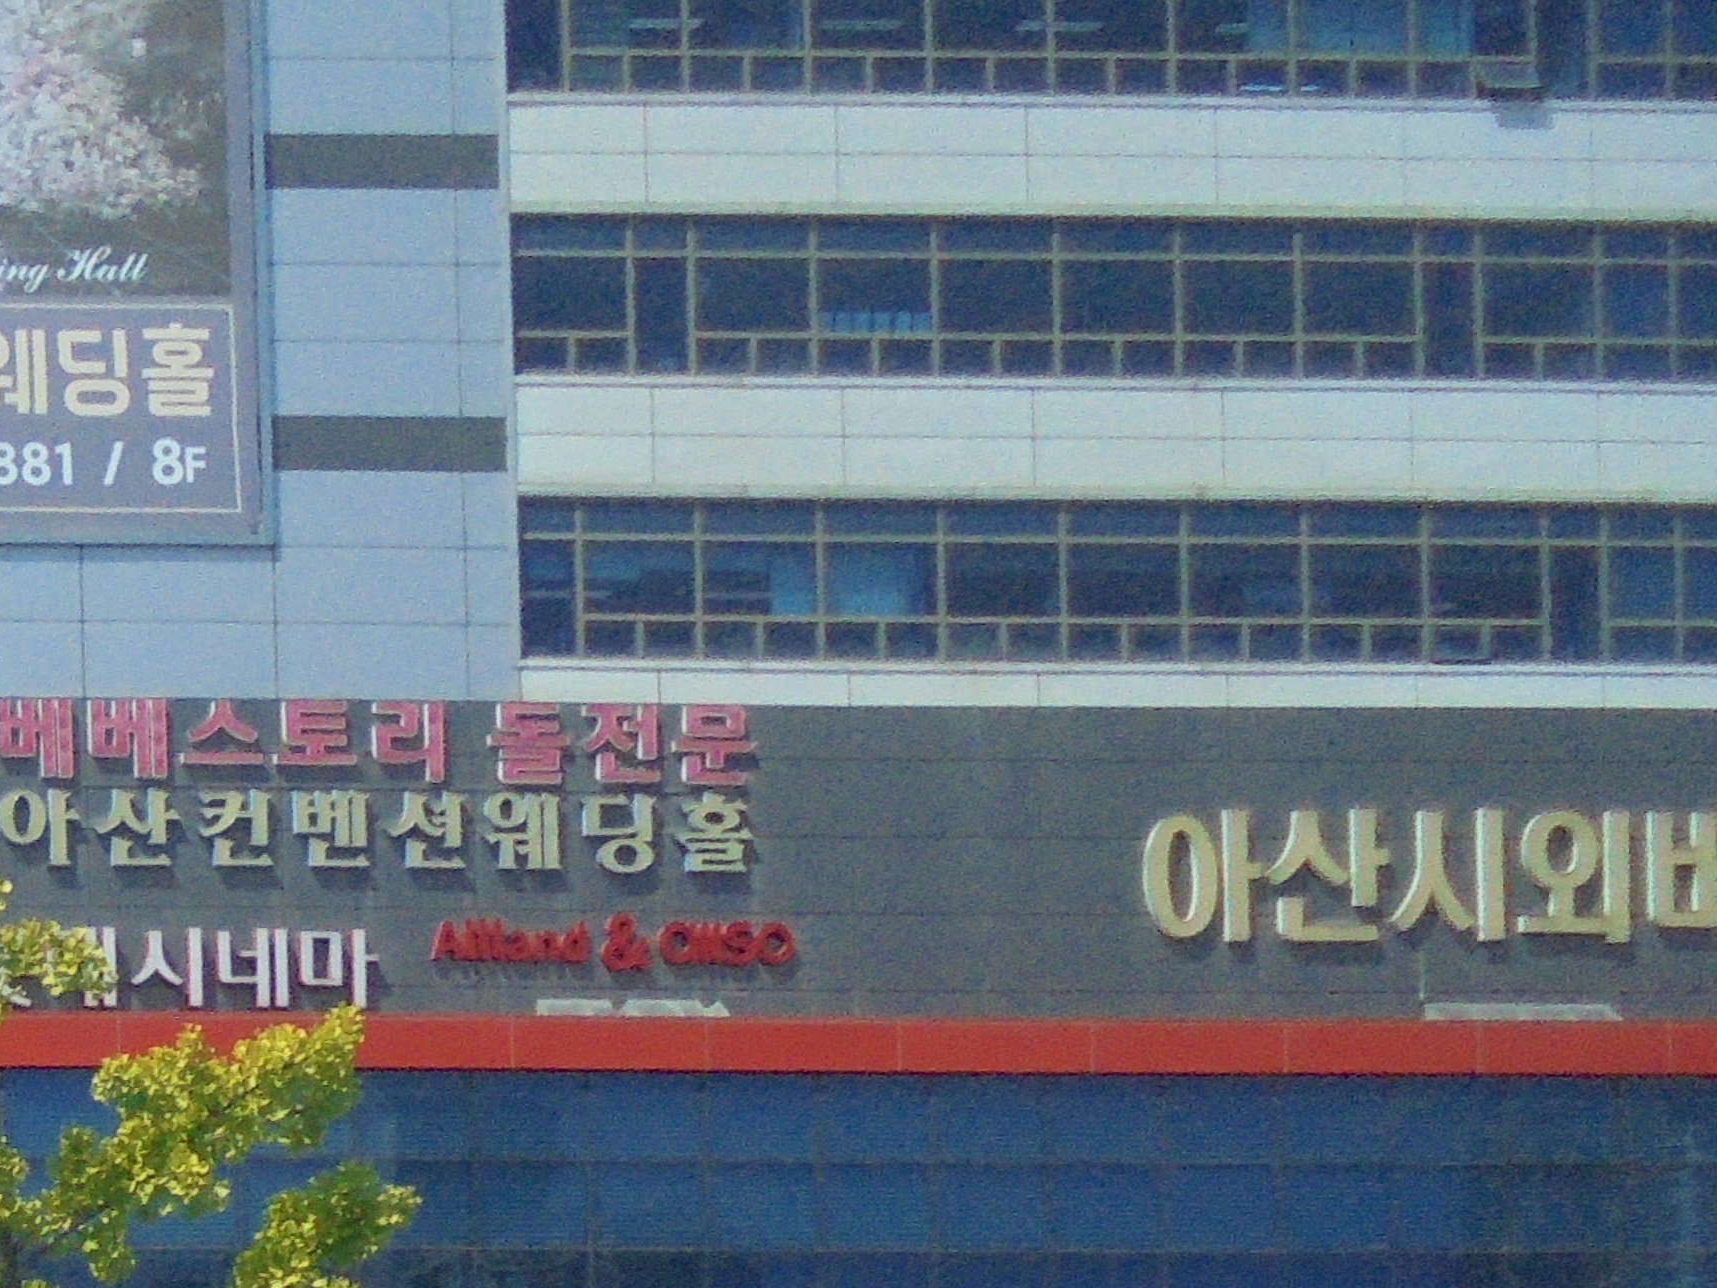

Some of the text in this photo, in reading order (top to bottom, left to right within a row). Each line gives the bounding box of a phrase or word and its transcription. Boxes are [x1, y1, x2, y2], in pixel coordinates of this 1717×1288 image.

[57, 247, 150, 284] Hall
[151, 438, 207, 486] 8F
[489, 702, 757, 785] 돌전문
[600, 911, 655, 972] &
